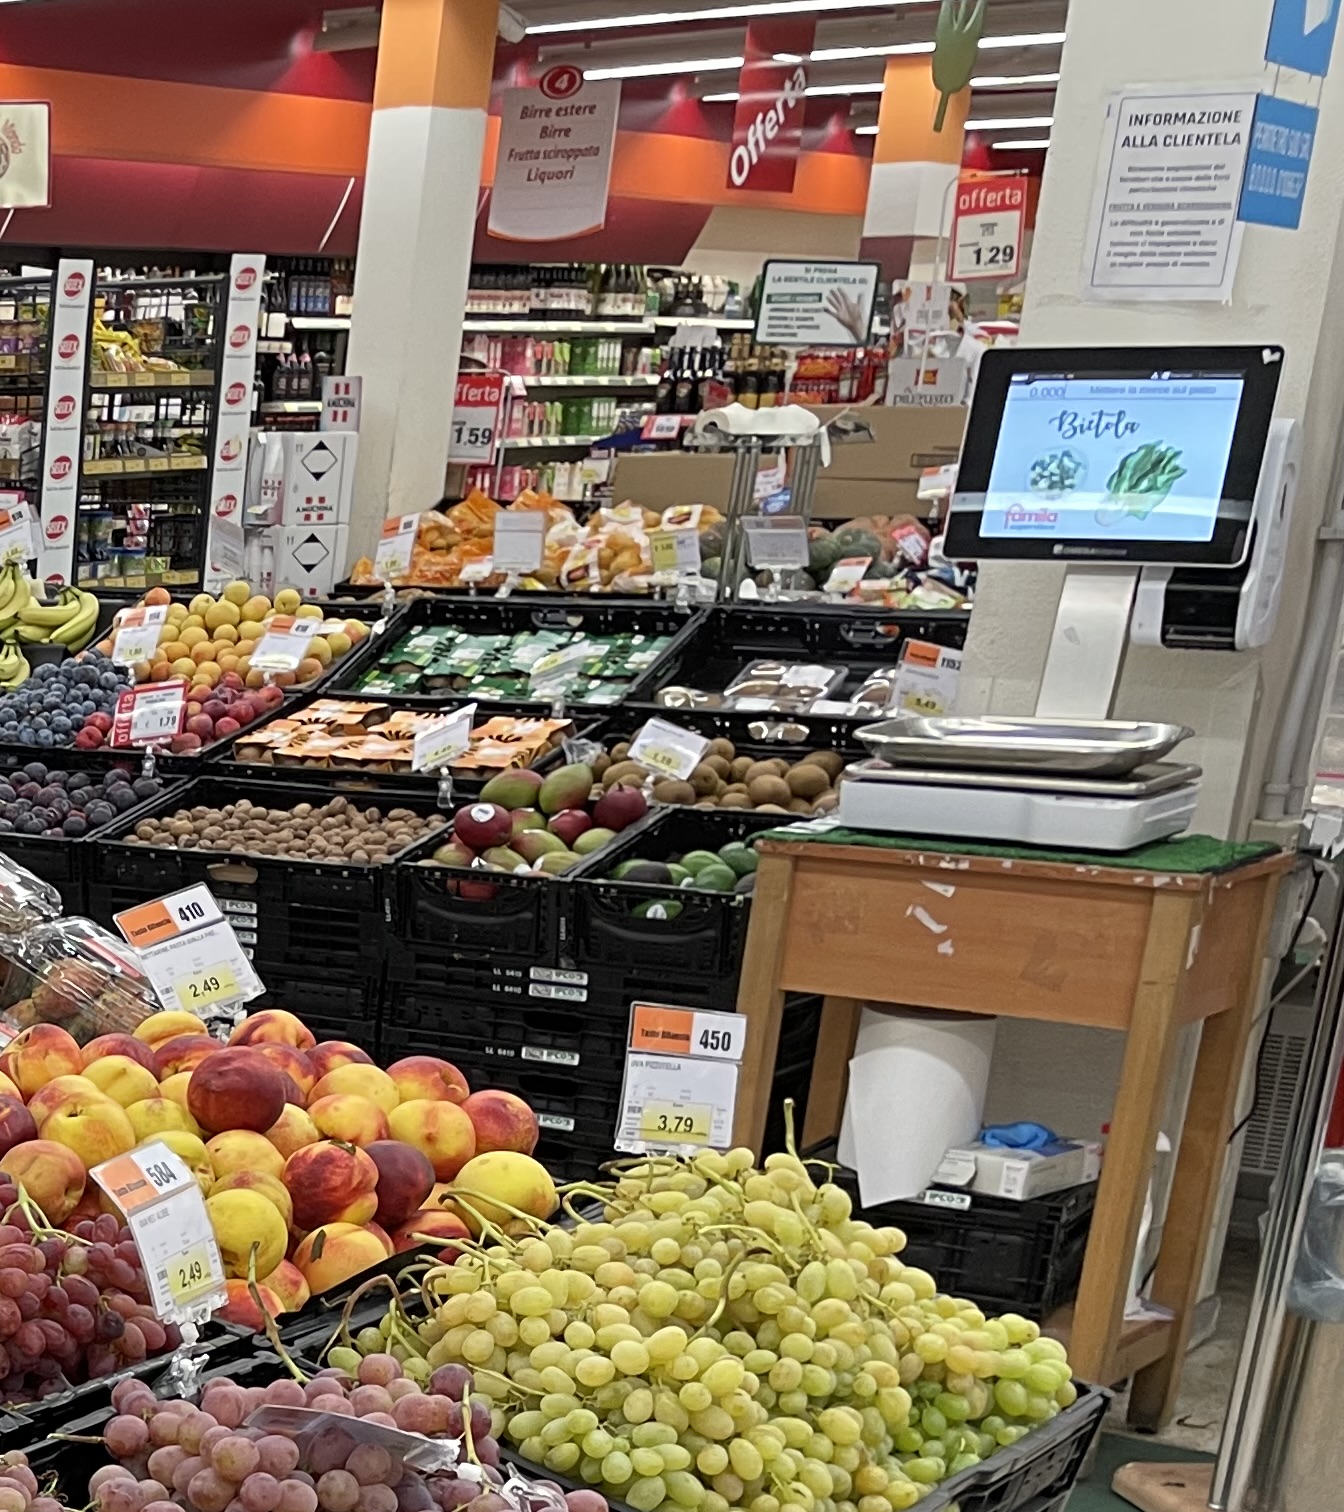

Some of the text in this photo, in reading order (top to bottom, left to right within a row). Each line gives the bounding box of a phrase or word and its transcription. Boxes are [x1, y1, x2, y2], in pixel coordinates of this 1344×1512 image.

[558, 74, 569, 89] 4
[520, 103, 596, 119] Birre estere
[1129, 110, 1243, 126] INFORMAZIONE
[540, 125, 571, 139] Birre
[730, 67, 806, 186] Offerta
[1122, 132, 1241, 148] ALLA CLIENTELA
[508, 148, 540, 161] Frutta
[527, 166, 574, 182] Liquori
[959, 188, 1022, 210] offerta
[453, 385, 499, 402] fferta
[1049, 409, 1140, 439] Bietola
[178, 902, 204, 922] 410
[189, 977, 220, 998] 2,49
[699, 1029, 731, 1051] 450
[658, 1115, 694, 1134] 3,79
[146, 1161, 177, 1186] 584
[179, 1261, 202, 1288] 2,49
